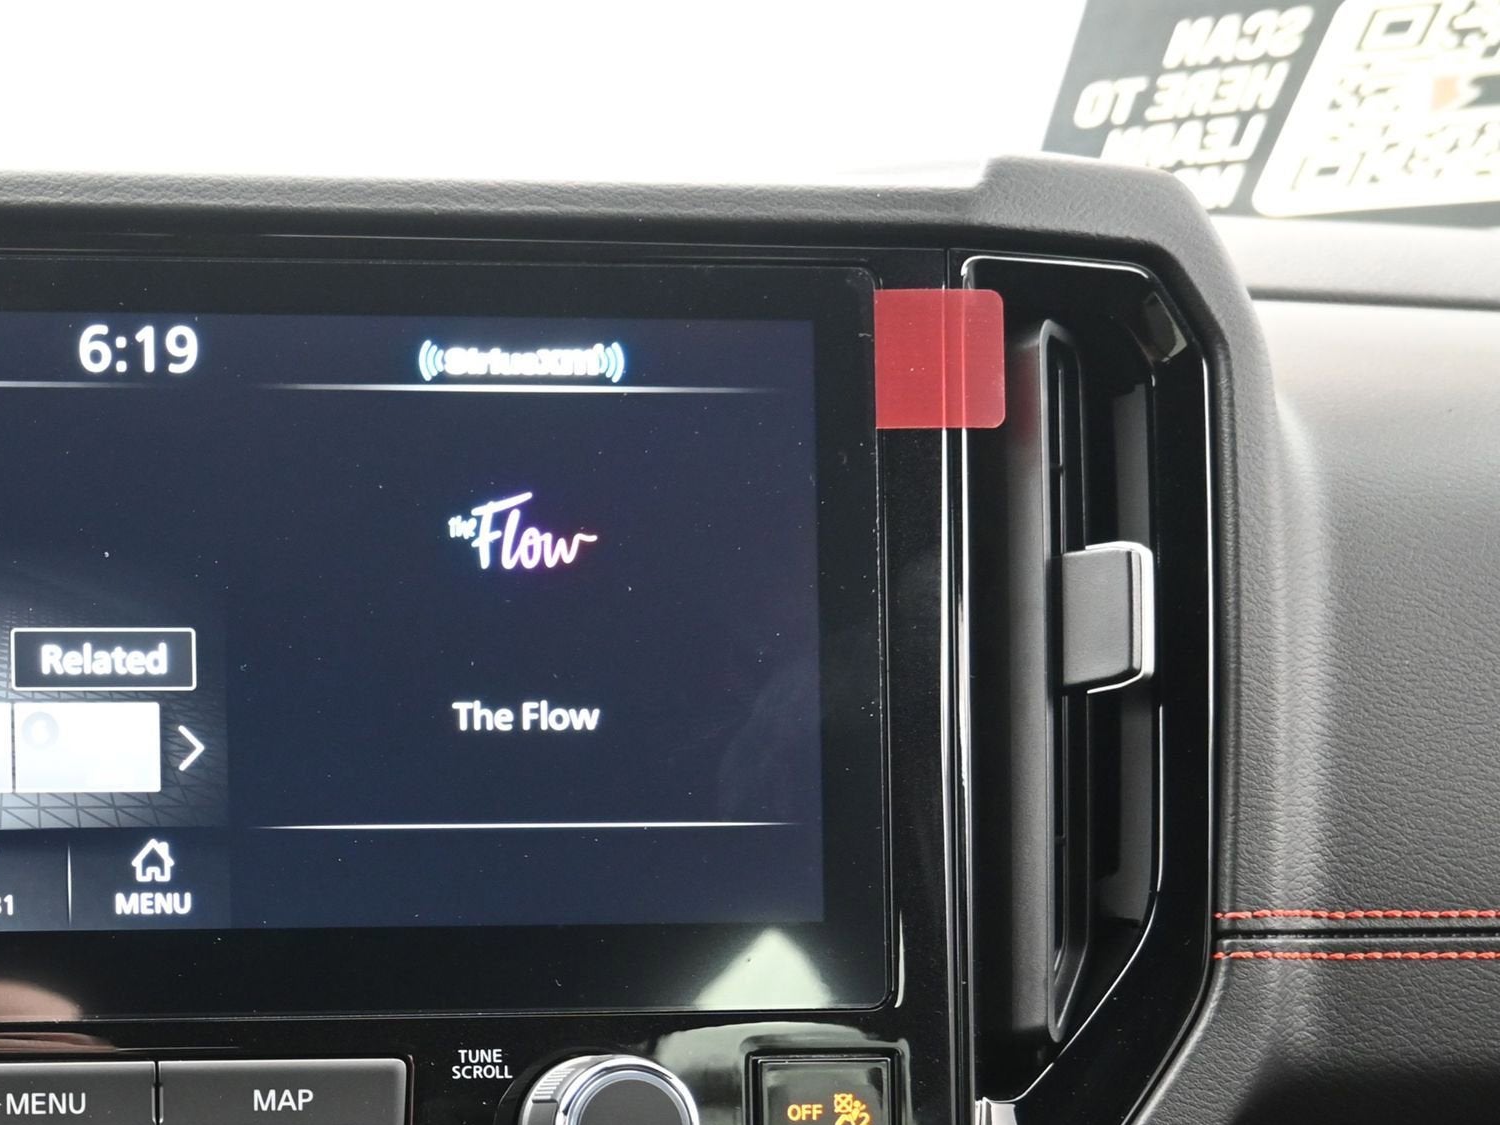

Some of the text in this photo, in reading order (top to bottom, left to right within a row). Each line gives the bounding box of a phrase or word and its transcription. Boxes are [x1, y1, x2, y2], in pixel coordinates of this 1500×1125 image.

[78, 323, 199, 374] 6:19
[471, 491, 598, 570] Flow
[40, 641, 169, 676] Related
[451, 699, 601, 732] The Flow
[114, 891, 192, 916] MENU
[457, 1048, 504, 1064] TUNE
[451, 1062, 513, 1081] SCROLL
[6, 1092, 86, 1115] MENU
[253, 1088, 314, 1112] MAP
[787, 1103, 824, 1122] OFF
